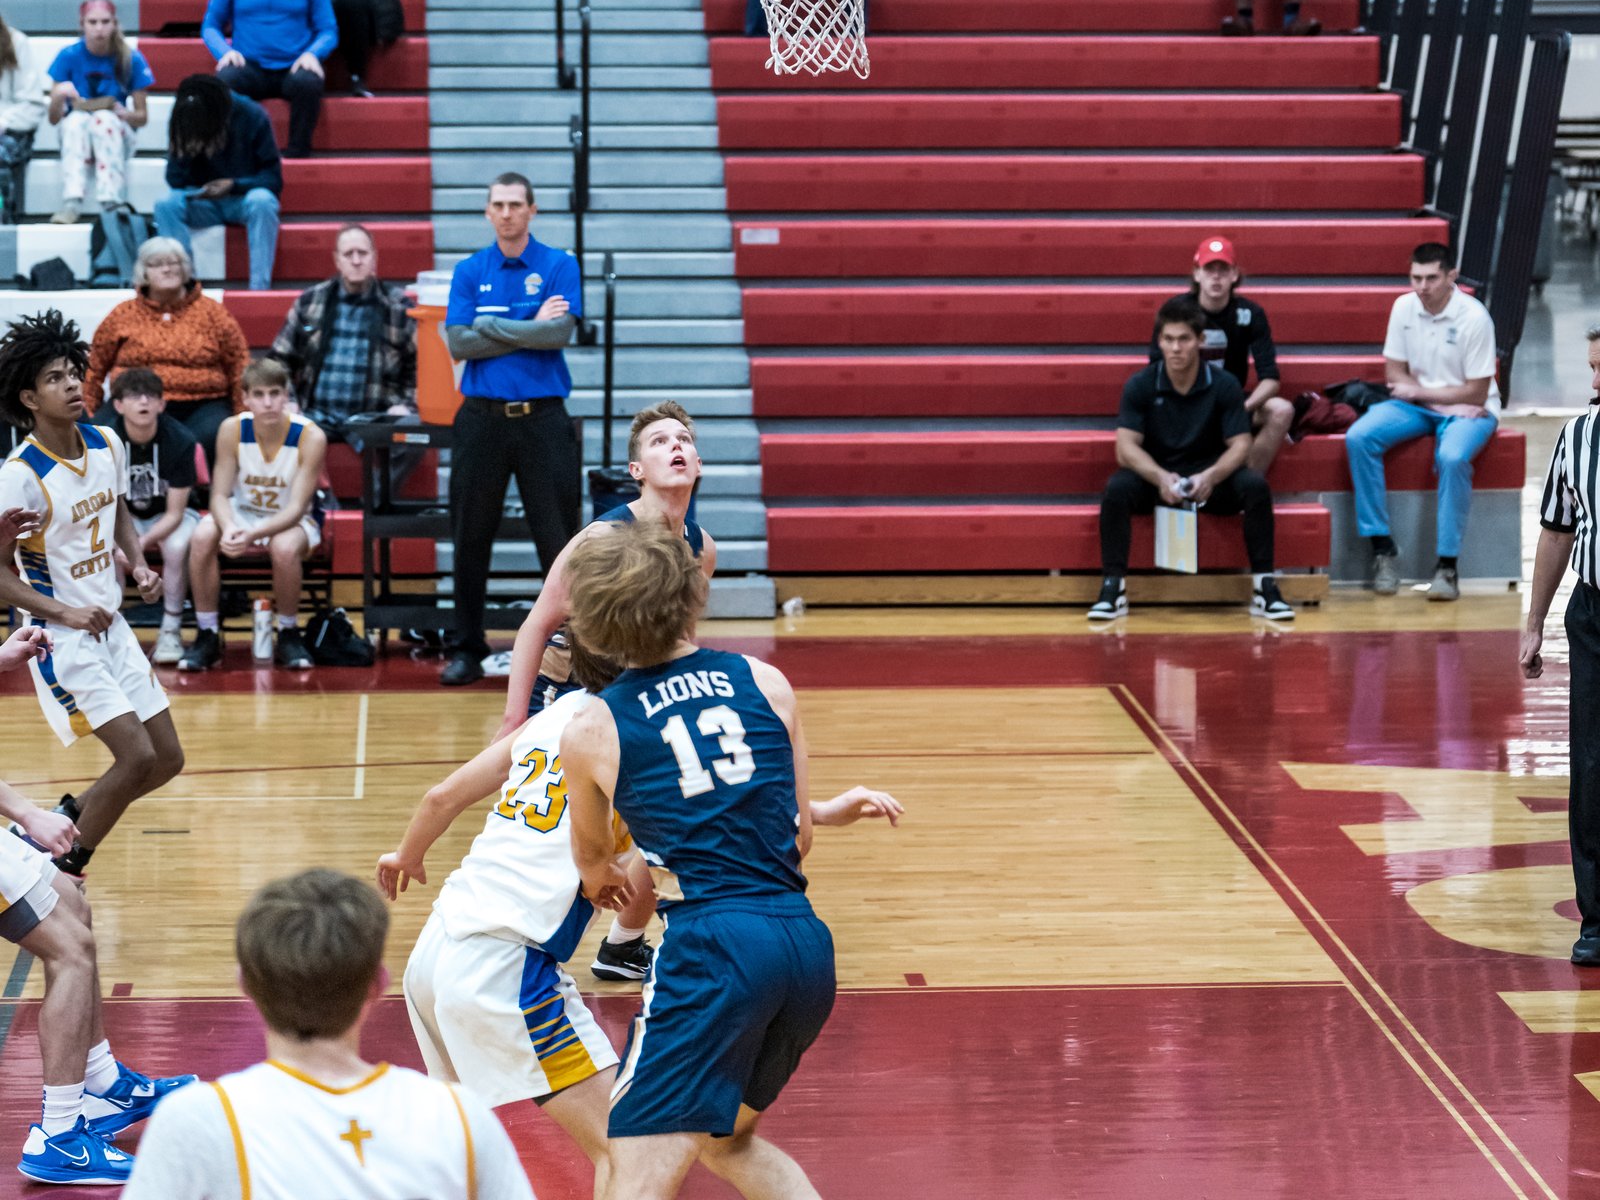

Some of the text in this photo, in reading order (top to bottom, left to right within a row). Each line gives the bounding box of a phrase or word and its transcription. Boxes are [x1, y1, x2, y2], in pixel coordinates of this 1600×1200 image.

[87, 516, 105, 554] 2
[637, 670, 735, 719] LIONS
[660, 704, 756, 799] 13
[494, 747, 569, 834] 23
